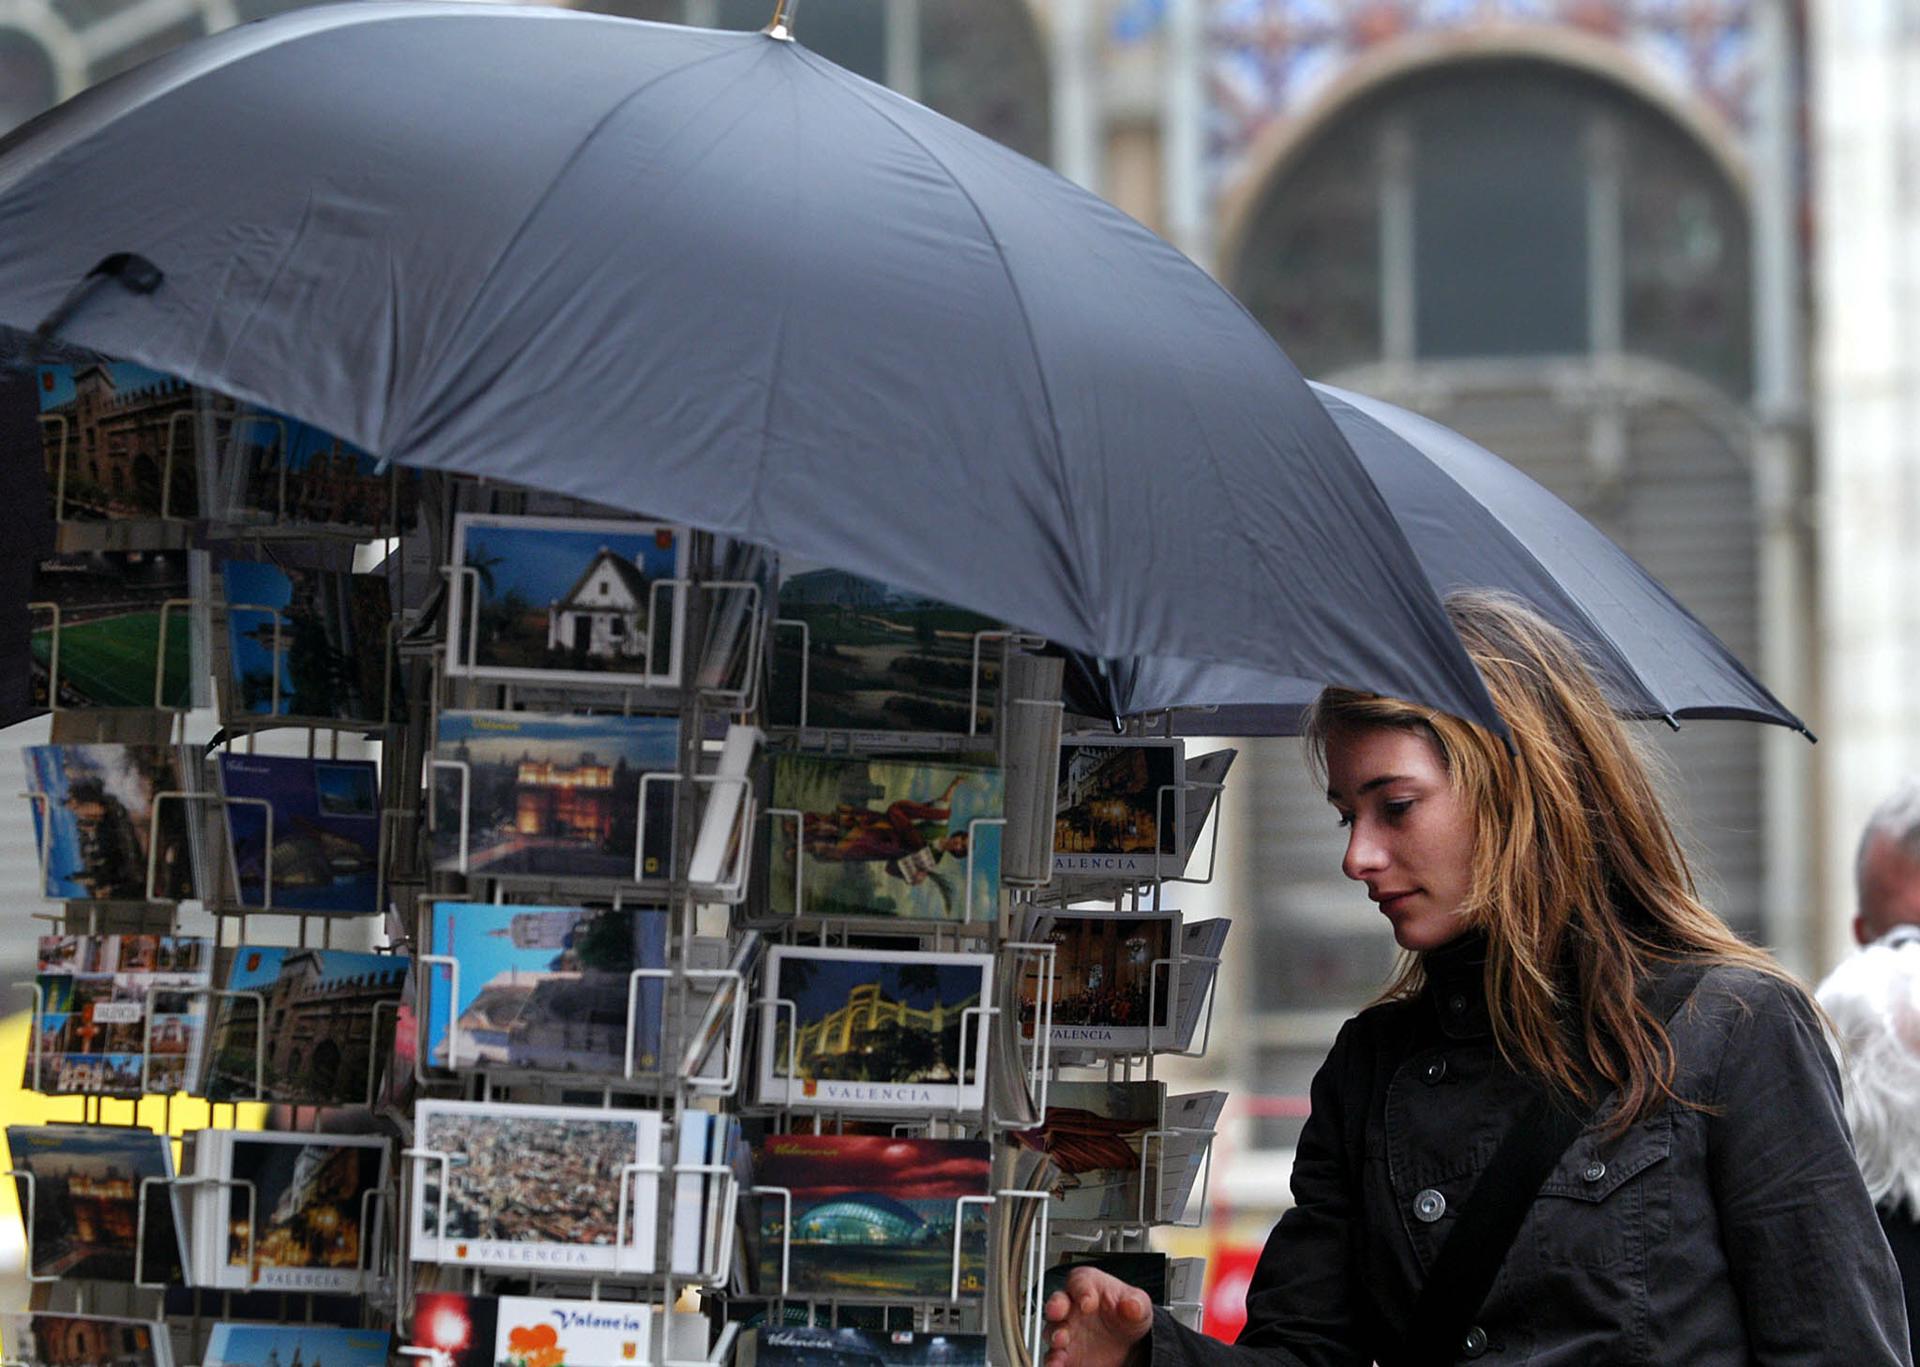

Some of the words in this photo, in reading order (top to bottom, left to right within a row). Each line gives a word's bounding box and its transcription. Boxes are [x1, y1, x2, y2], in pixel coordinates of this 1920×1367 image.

[1055, 858, 1136, 869] ALENCIA
[828, 1086, 930, 1101] VALENCIA
[480, 1246, 587, 1262] VALENCIA
[267, 1273, 341, 1286] VALENCIA
[552, 1310, 640, 1329] Valencia
